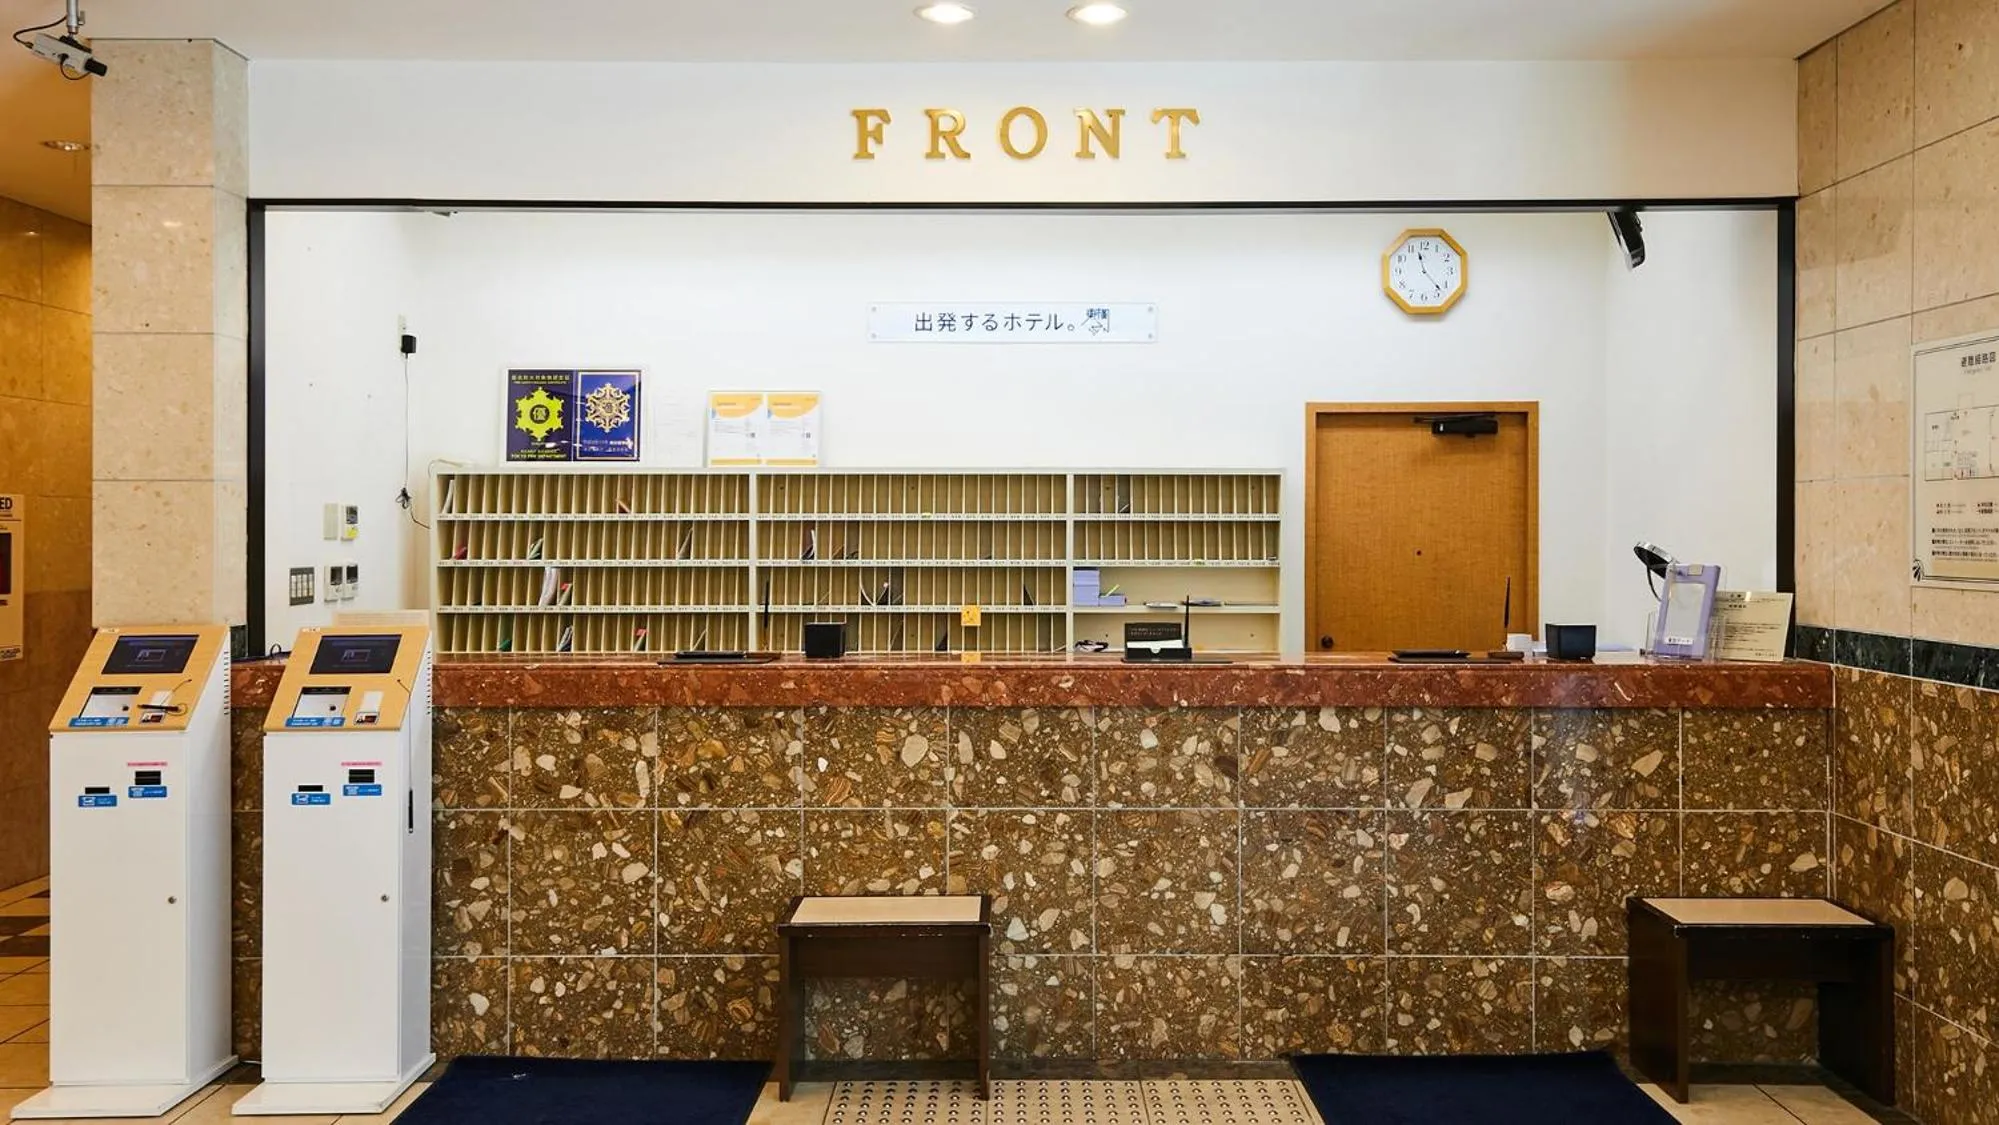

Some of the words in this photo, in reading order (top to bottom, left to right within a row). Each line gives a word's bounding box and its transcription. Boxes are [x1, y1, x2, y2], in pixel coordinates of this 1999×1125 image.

[851, 106, 1201, 160] FRONT
[914, 311, 1076, 333] 出発するホテル。
